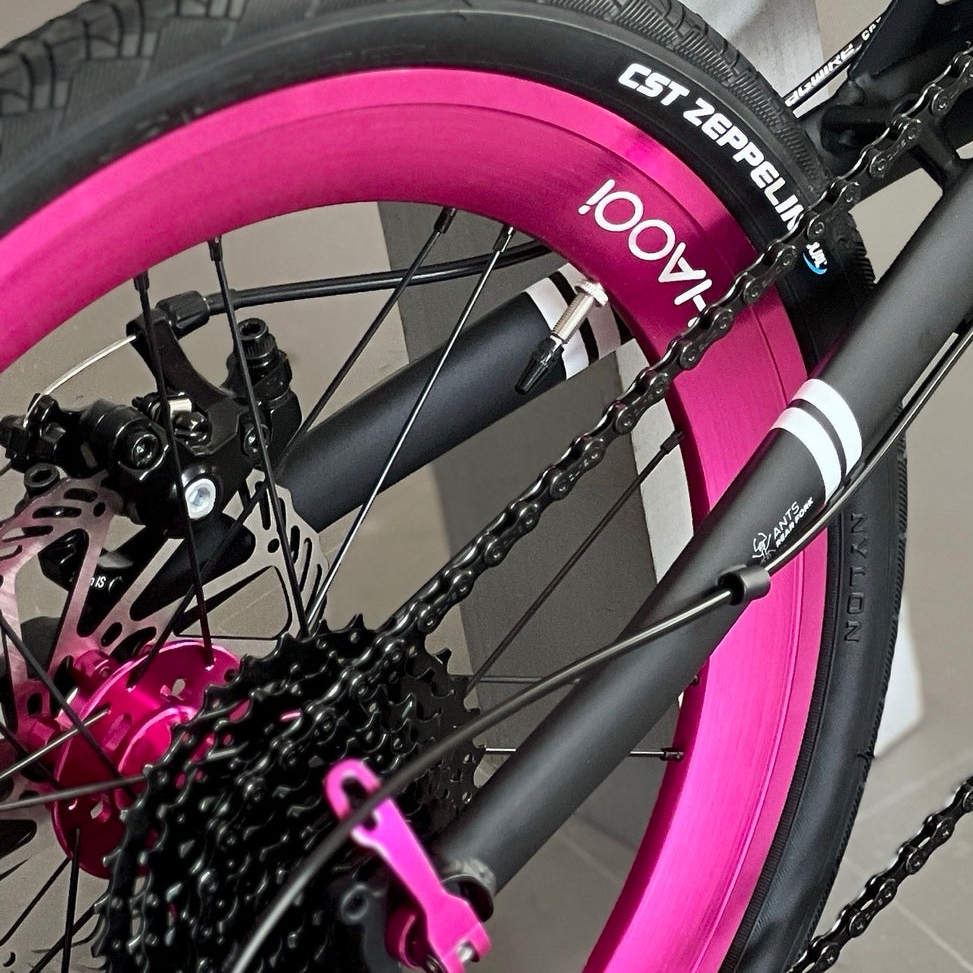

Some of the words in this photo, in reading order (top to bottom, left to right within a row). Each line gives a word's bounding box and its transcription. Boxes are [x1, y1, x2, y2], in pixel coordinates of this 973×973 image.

[618, 63, 690, 106] CST
[784, 43, 855, 107] AGWIRE
[772, 500, 800, 538] ANTS
[844, 512, 870, 644] NYLON
